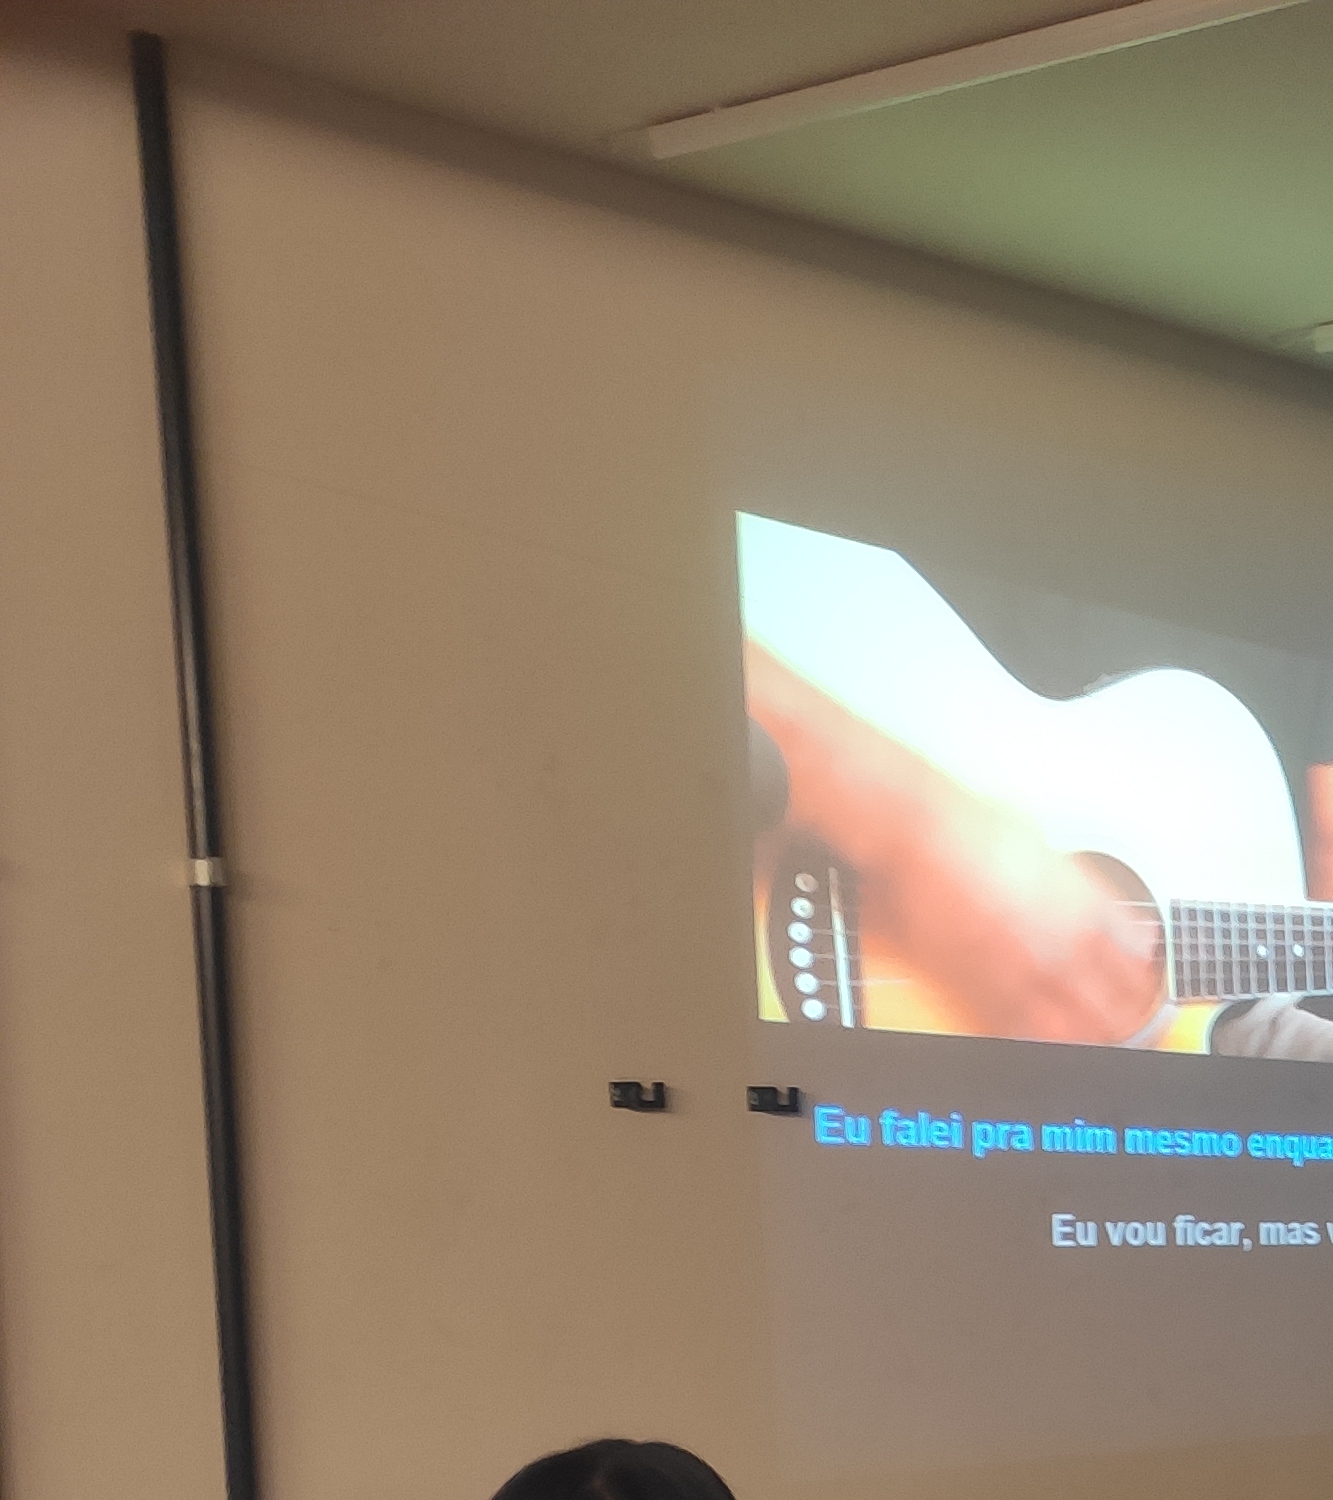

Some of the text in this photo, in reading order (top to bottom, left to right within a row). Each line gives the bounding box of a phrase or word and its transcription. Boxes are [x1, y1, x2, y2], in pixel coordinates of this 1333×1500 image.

[813, 1104, 872, 1147] Eu
[878, 1107, 965, 1150] falei
[971, 1119, 1035, 1160] pra
[1041, 1117, 1118, 1156] mim
[1124, 1126, 1243, 1158] mesmo
[1051, 1212, 1098, 1247] Eu
[1104, 1220, 1167, 1247] vou
[1173, 1213, 1253, 1252] ficar,
[1258, 1220, 1322, 1246] mas
